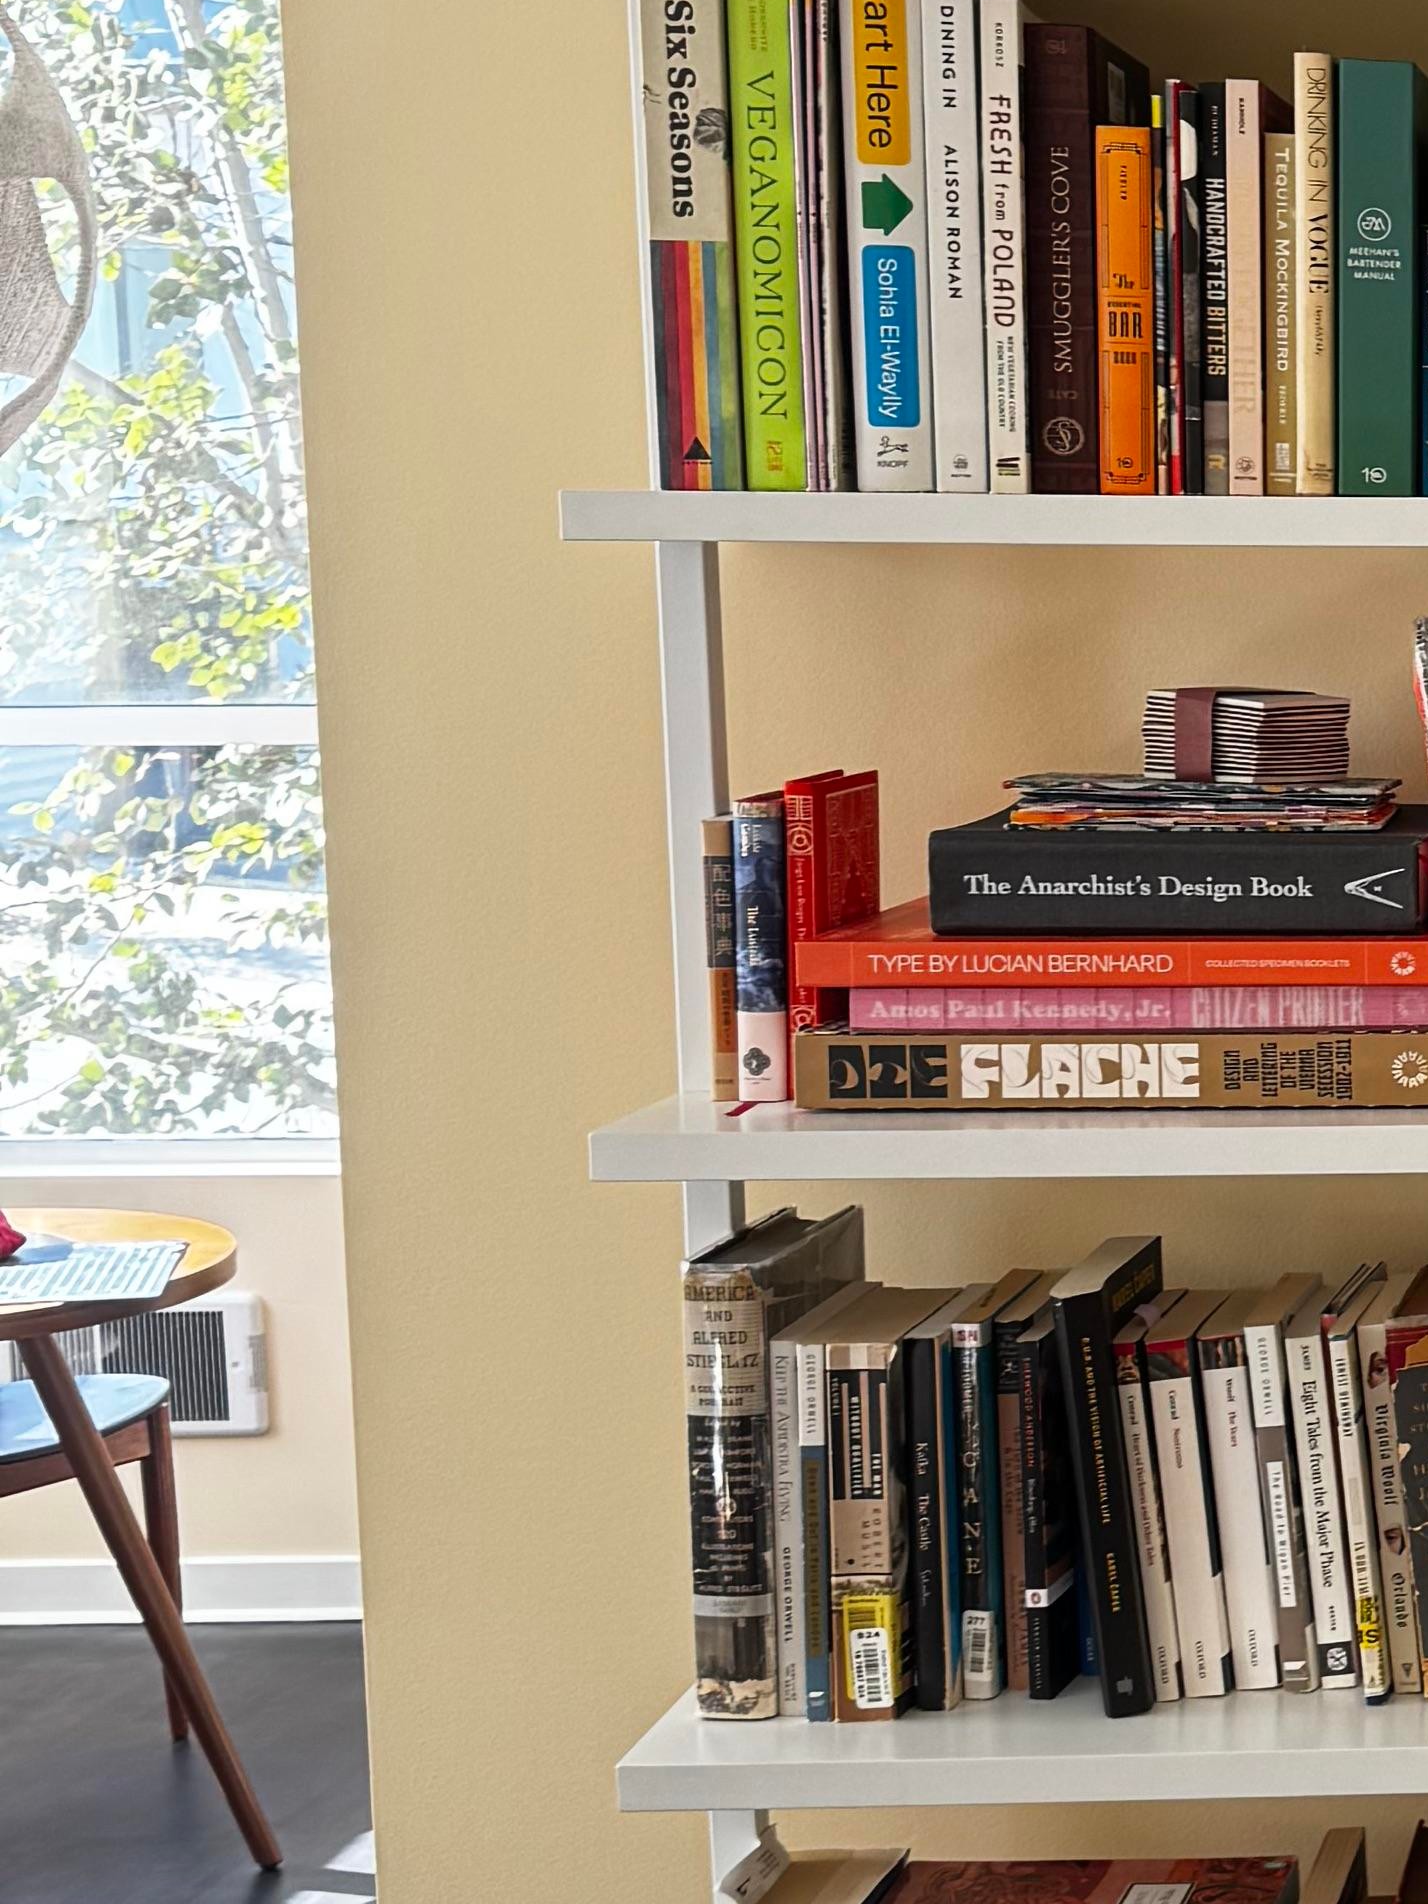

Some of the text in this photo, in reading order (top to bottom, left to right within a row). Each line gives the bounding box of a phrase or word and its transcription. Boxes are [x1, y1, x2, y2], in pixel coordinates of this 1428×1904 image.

[663, 0, 694, 218] Six Seasons
[866, 65, 892, 148] Here
[939, 4, 963, 299] DINING IN ALISON ROMAN
[745, 71, 787, 420] VEGANOMICON
[989, 96, 1016, 327] FRESH from POLAND
[1205, 178, 1227, 376] HANDCRAFTED BITTERS
[876, 258, 902, 418] Sohla El-Waylly
[867, 953, 1173, 973] TYPE BY LUCIAN BERNHARD
[963, 874, 1313, 902] The Anarchist's Design Book
